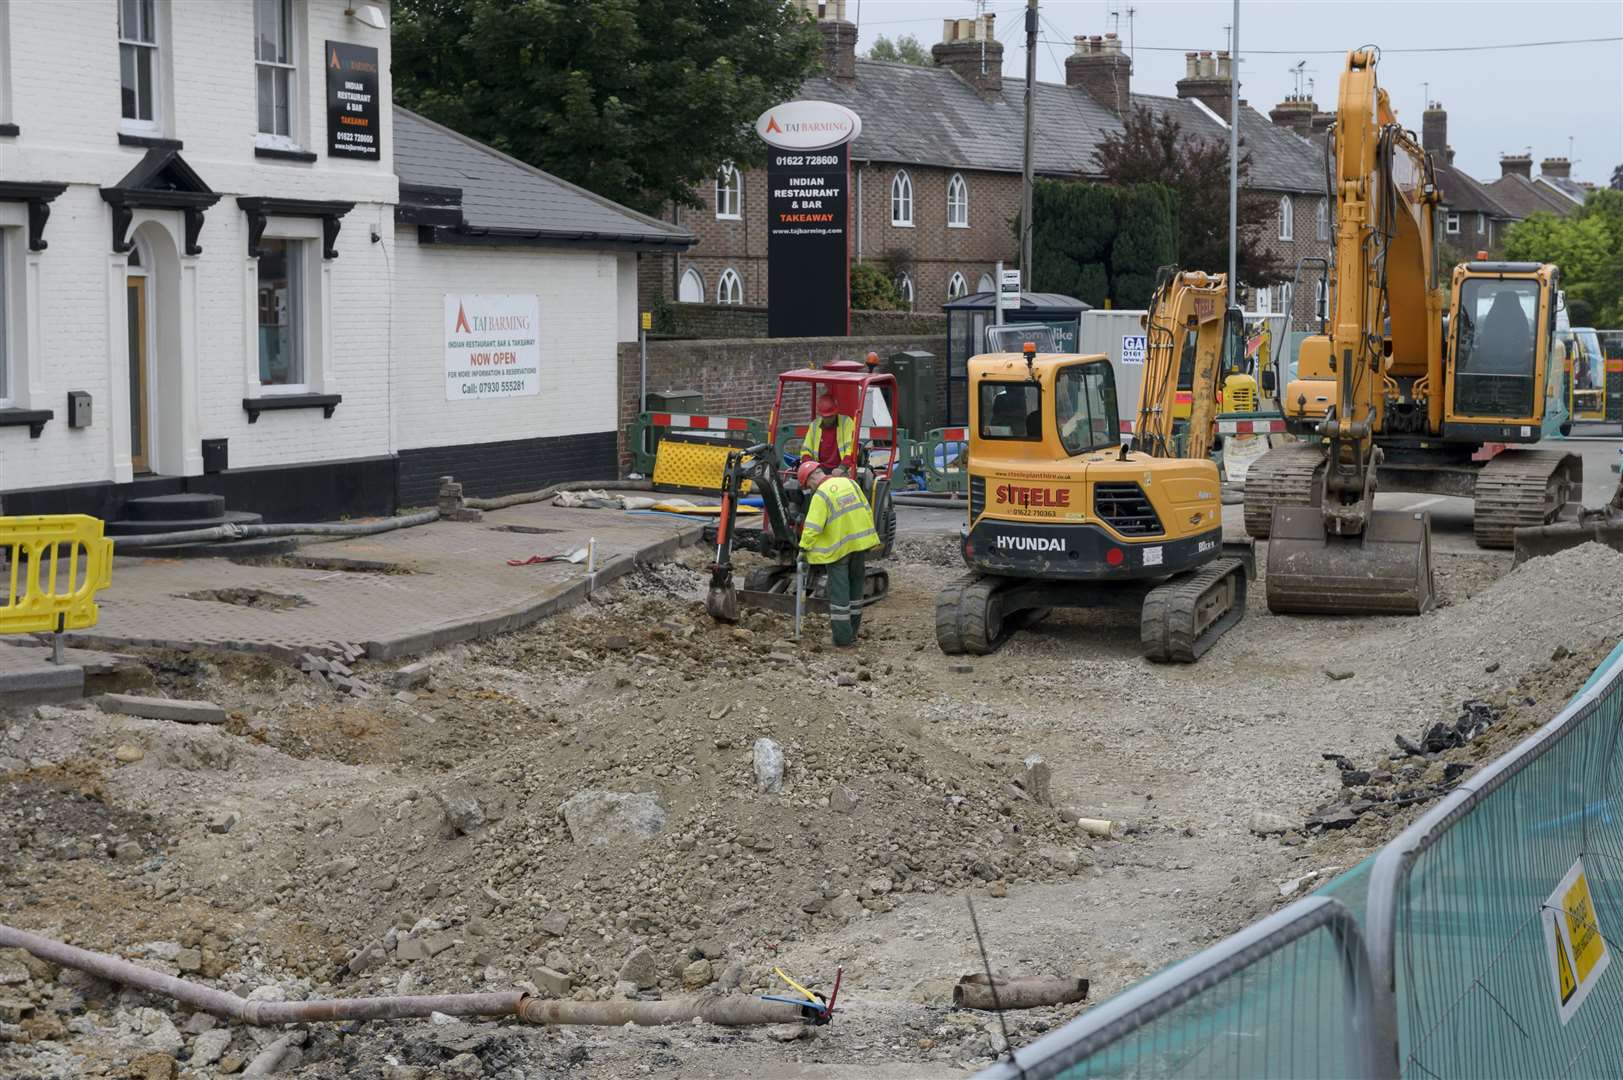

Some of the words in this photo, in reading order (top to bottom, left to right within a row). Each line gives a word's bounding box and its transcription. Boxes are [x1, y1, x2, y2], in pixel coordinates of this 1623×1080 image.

[345, 81, 364, 91] INDIAN
[337, 90, 371, 103] RESTAURANT
[346, 103, 351, 111] &
[351, 103, 363, 112] BAR
[340, 115, 368, 126] TAKEAWAY
[784, 123, 800, 133] TAJ
[801, 123, 848, 132] BARMING
[337, 131, 354, 141] 01622
[776, 156, 803, 166] 01622
[806, 155, 838, 165] 728600
[789, 178, 824, 186] INDIAN
[774, 189, 839, 198] RESTAURANT
[792, 200, 799, 209] &
[802, 200, 822, 208] BAR
[780, 214, 833, 222] TAKEAWAY
[473, 315, 487, 332] TAJ
[489, 315, 529, 331] BARMING
[448, 340, 465, 348] INDIAN
[497, 339, 507, 347] BAR
[511, 339, 536, 347] TAKEAWAY
[470, 353, 491, 366] NOW
[493, 352, 516, 364] OPEN
[458, 370, 471, 378] MORE
[471, 369, 500, 377] INFORMATION
[506, 367, 537, 376] RESERVATIONS
[462, 383, 478, 394] Call:
[479, 382, 500, 393] 07930
[501, 380, 525, 392] 555281
[996, 484, 1070, 507] STEELE
[1013, 508, 1031, 517] 01622
[1033, 509, 1056, 518] 710363
[997, 535, 1066, 551] HYUNDAI
